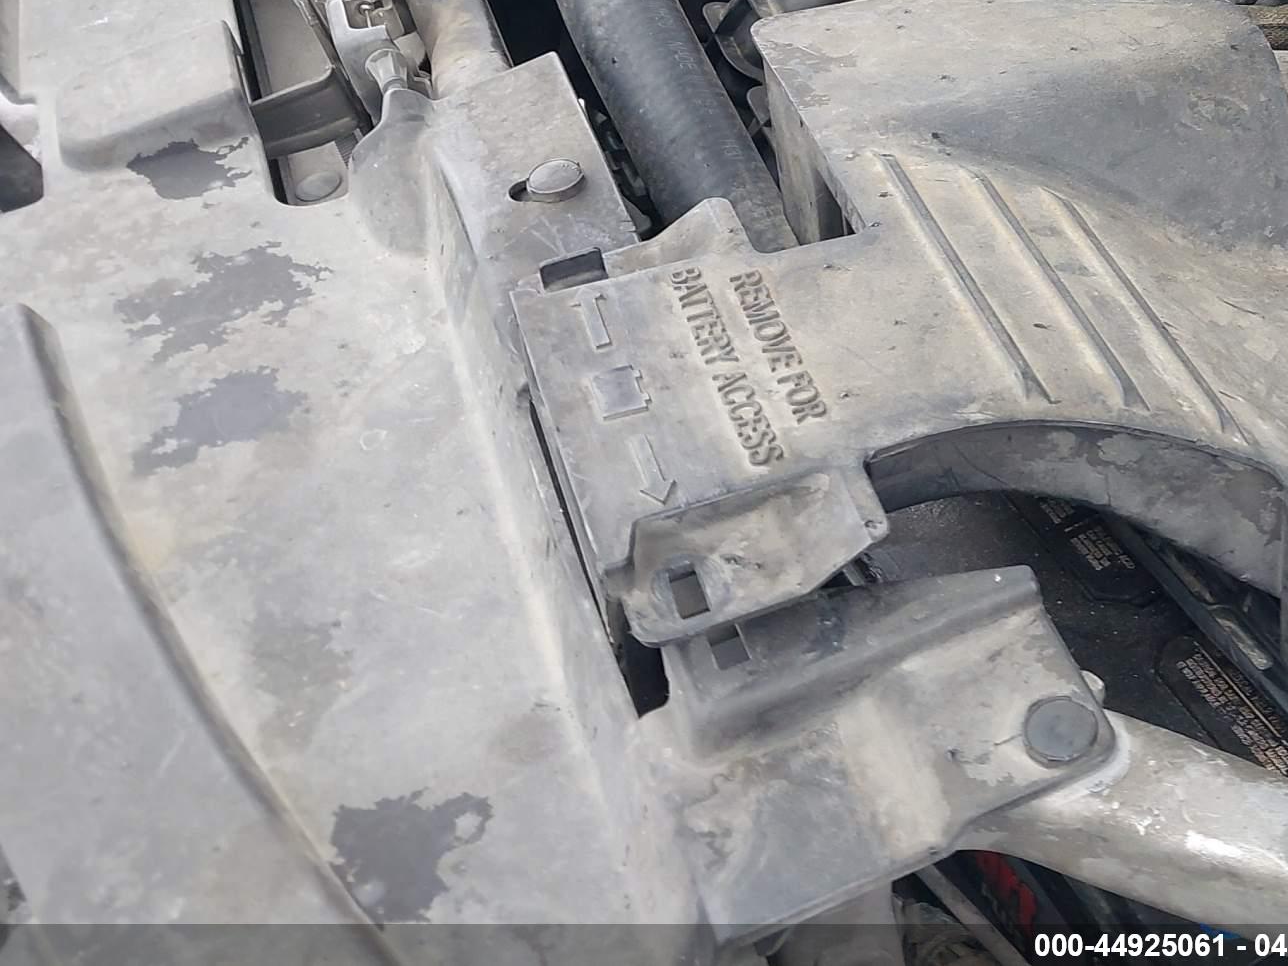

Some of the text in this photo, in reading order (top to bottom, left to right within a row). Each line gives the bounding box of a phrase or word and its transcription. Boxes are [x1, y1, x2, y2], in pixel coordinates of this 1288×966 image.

[671, 266, 784, 466] BATTERY ACCESS
[729, 269, 827, 425] REMOVE FOR
